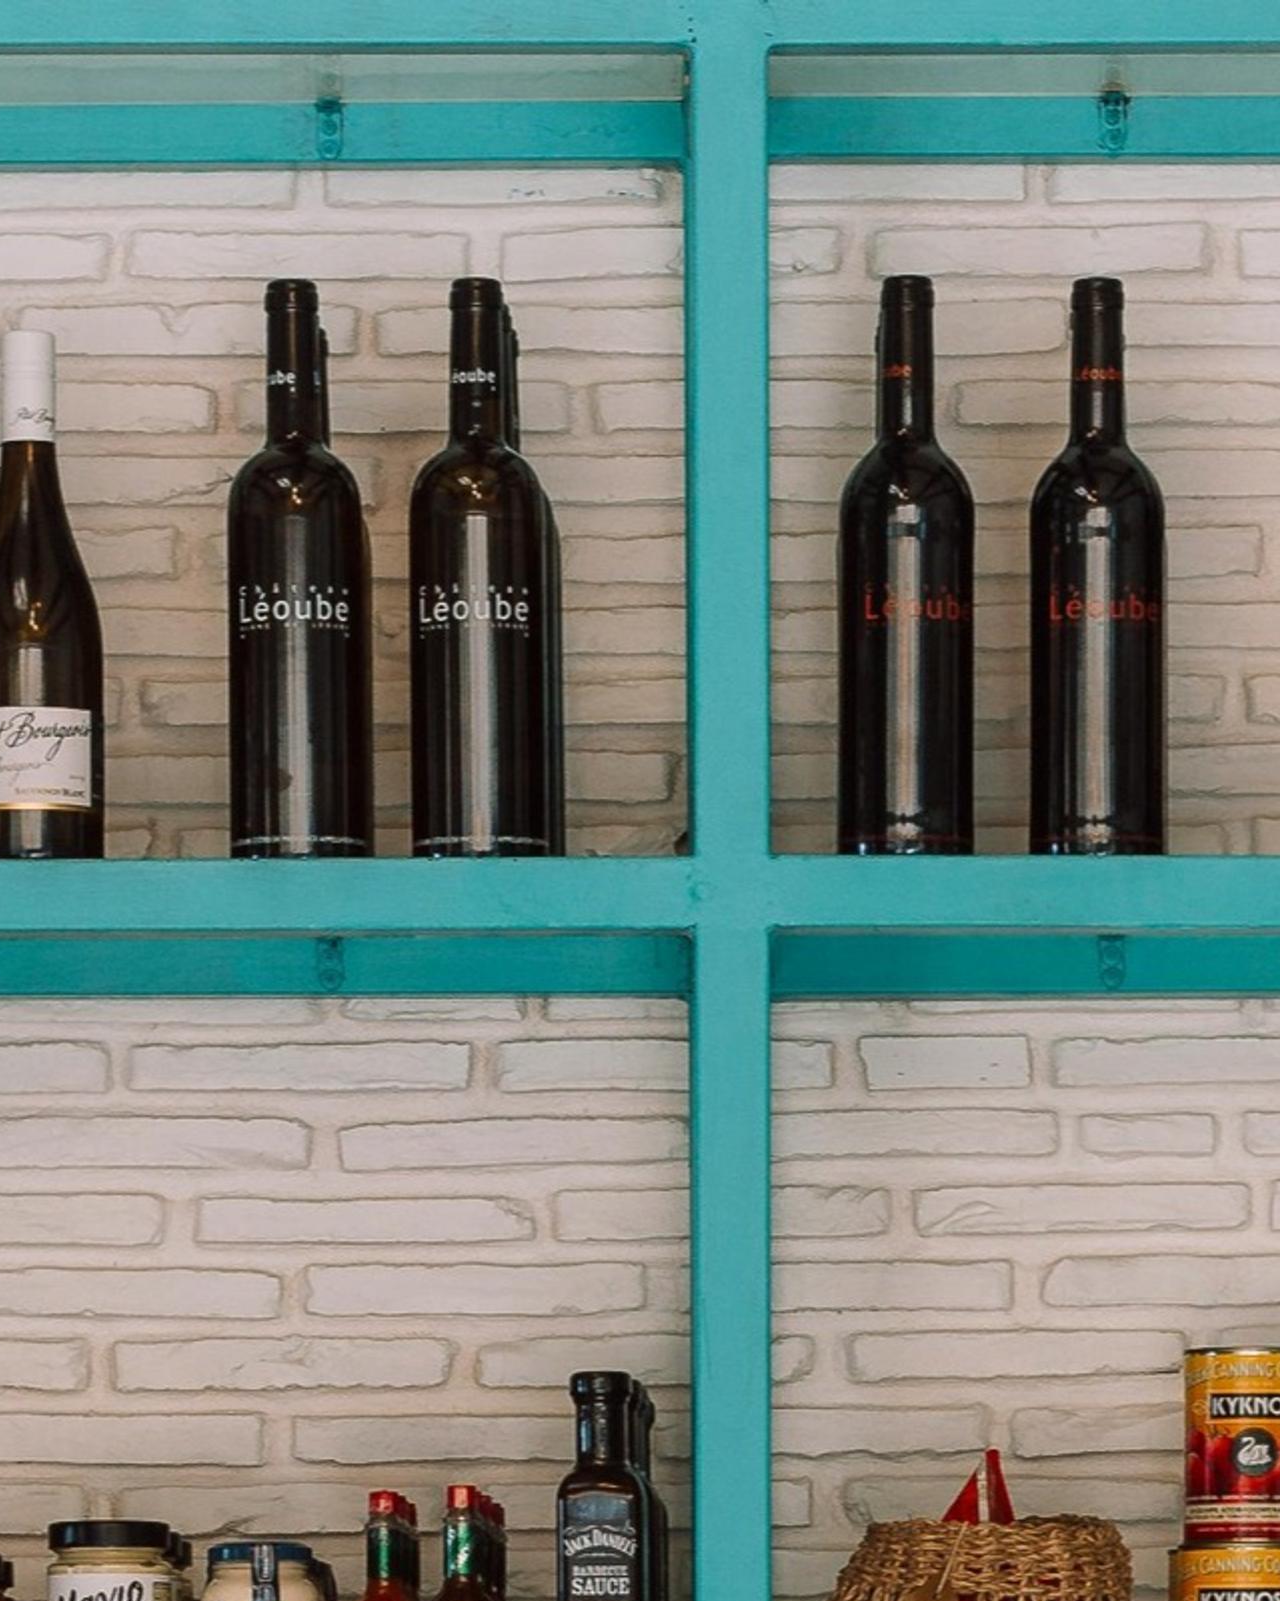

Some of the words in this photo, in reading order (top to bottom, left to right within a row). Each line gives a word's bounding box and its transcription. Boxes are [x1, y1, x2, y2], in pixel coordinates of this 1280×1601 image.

[239, 593, 350, 624] Léoube
[419, 593, 530, 624] Léoube
[571, 1577, 631, 1597] SAUCE
